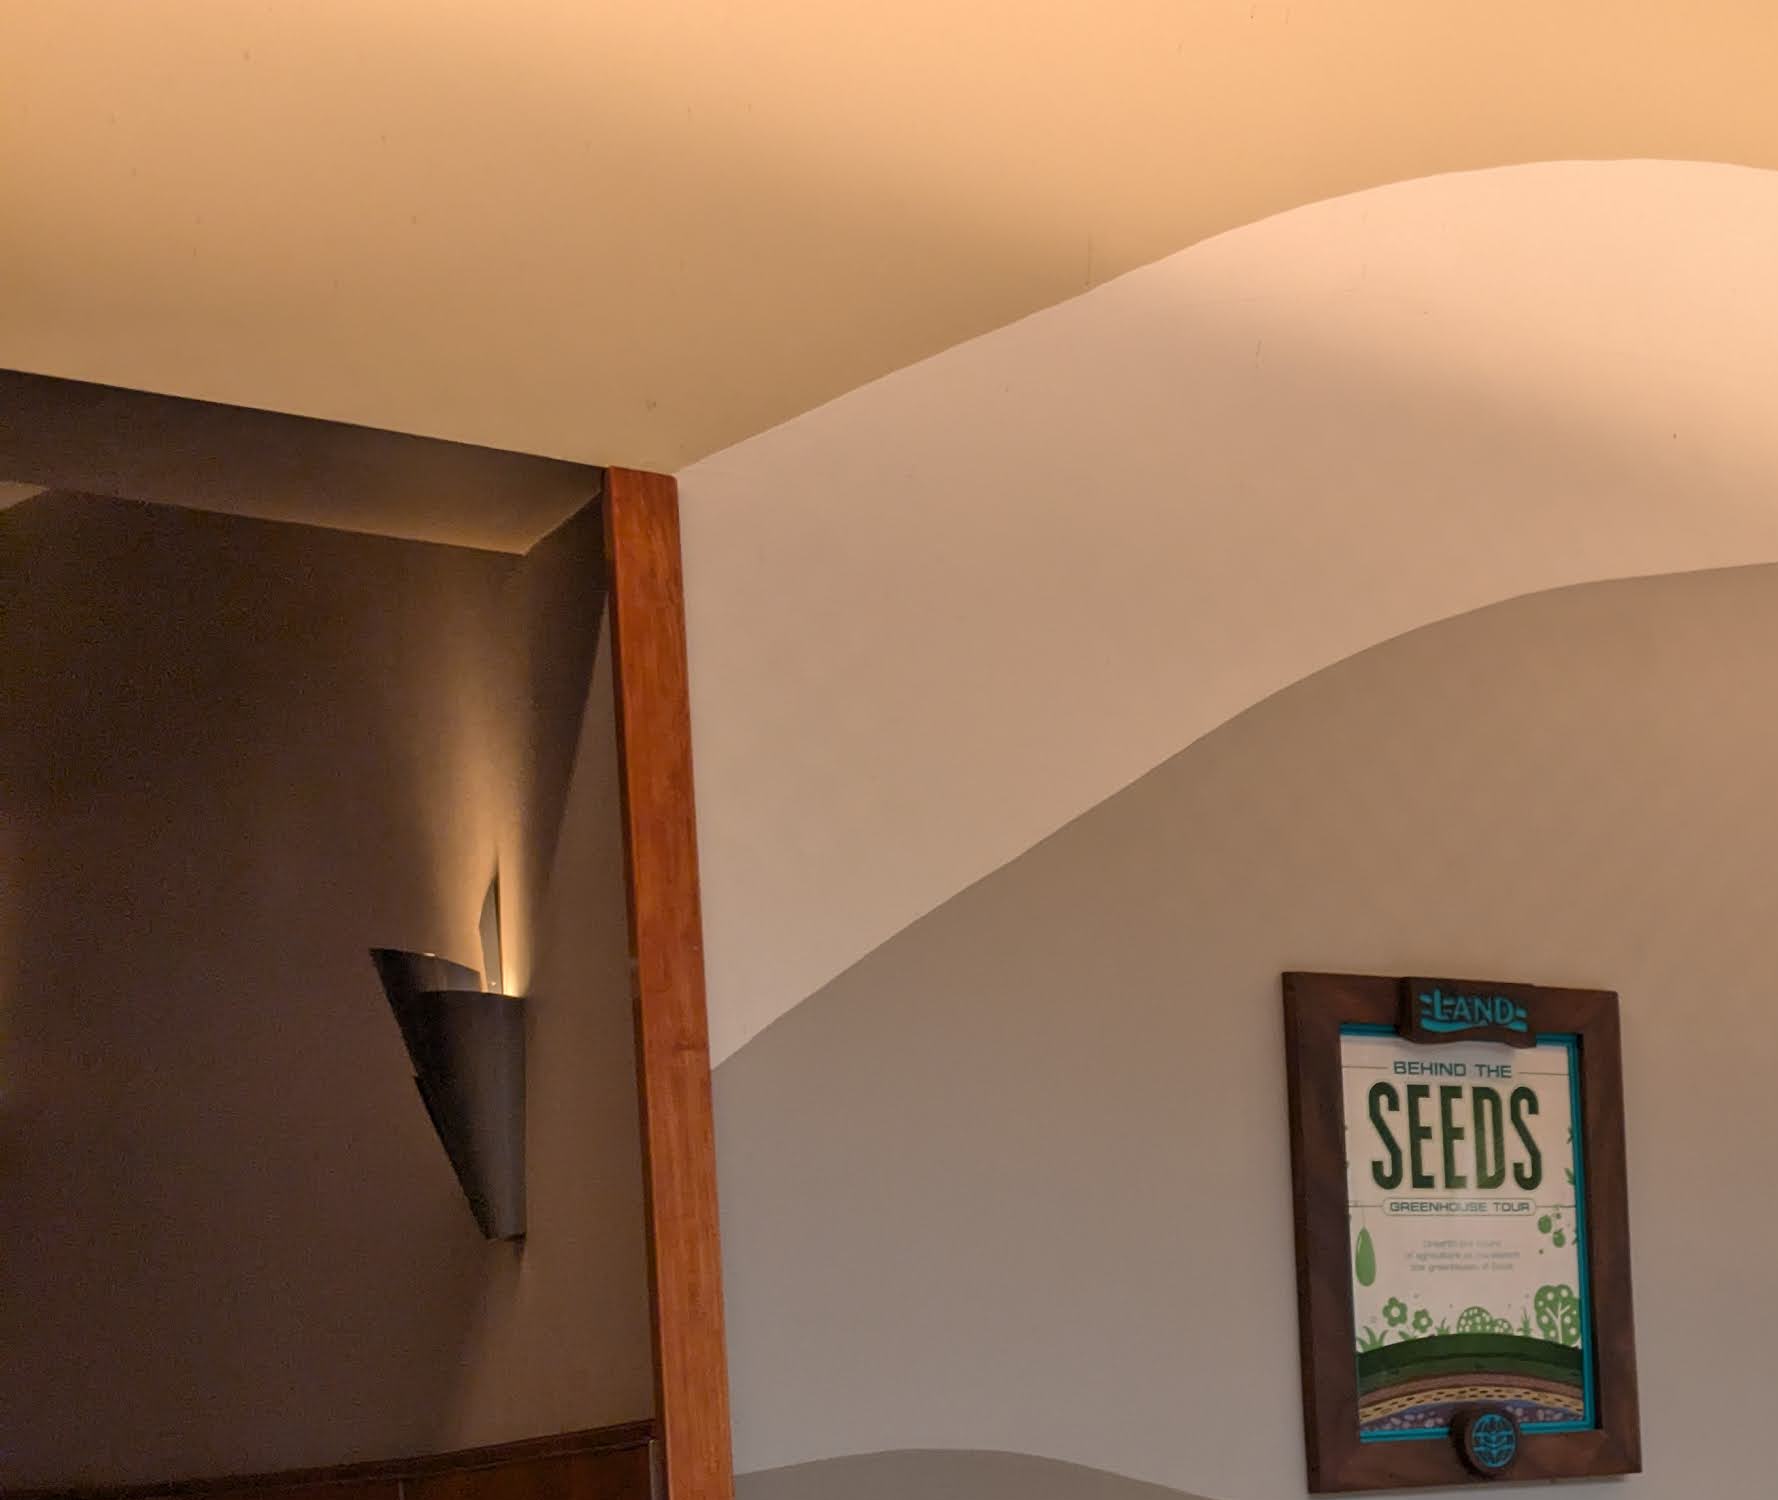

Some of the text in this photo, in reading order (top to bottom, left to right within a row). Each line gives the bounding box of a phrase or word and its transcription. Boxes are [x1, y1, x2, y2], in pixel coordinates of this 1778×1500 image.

[1433, 988, 1514, 1025] LAND
[1393, 1061, 1512, 1079] BEHIND THE
[1368, 1081, 1543, 1192] SEEDS
[1389, 1201, 1531, 1213] GREENHOUSE TOUR
